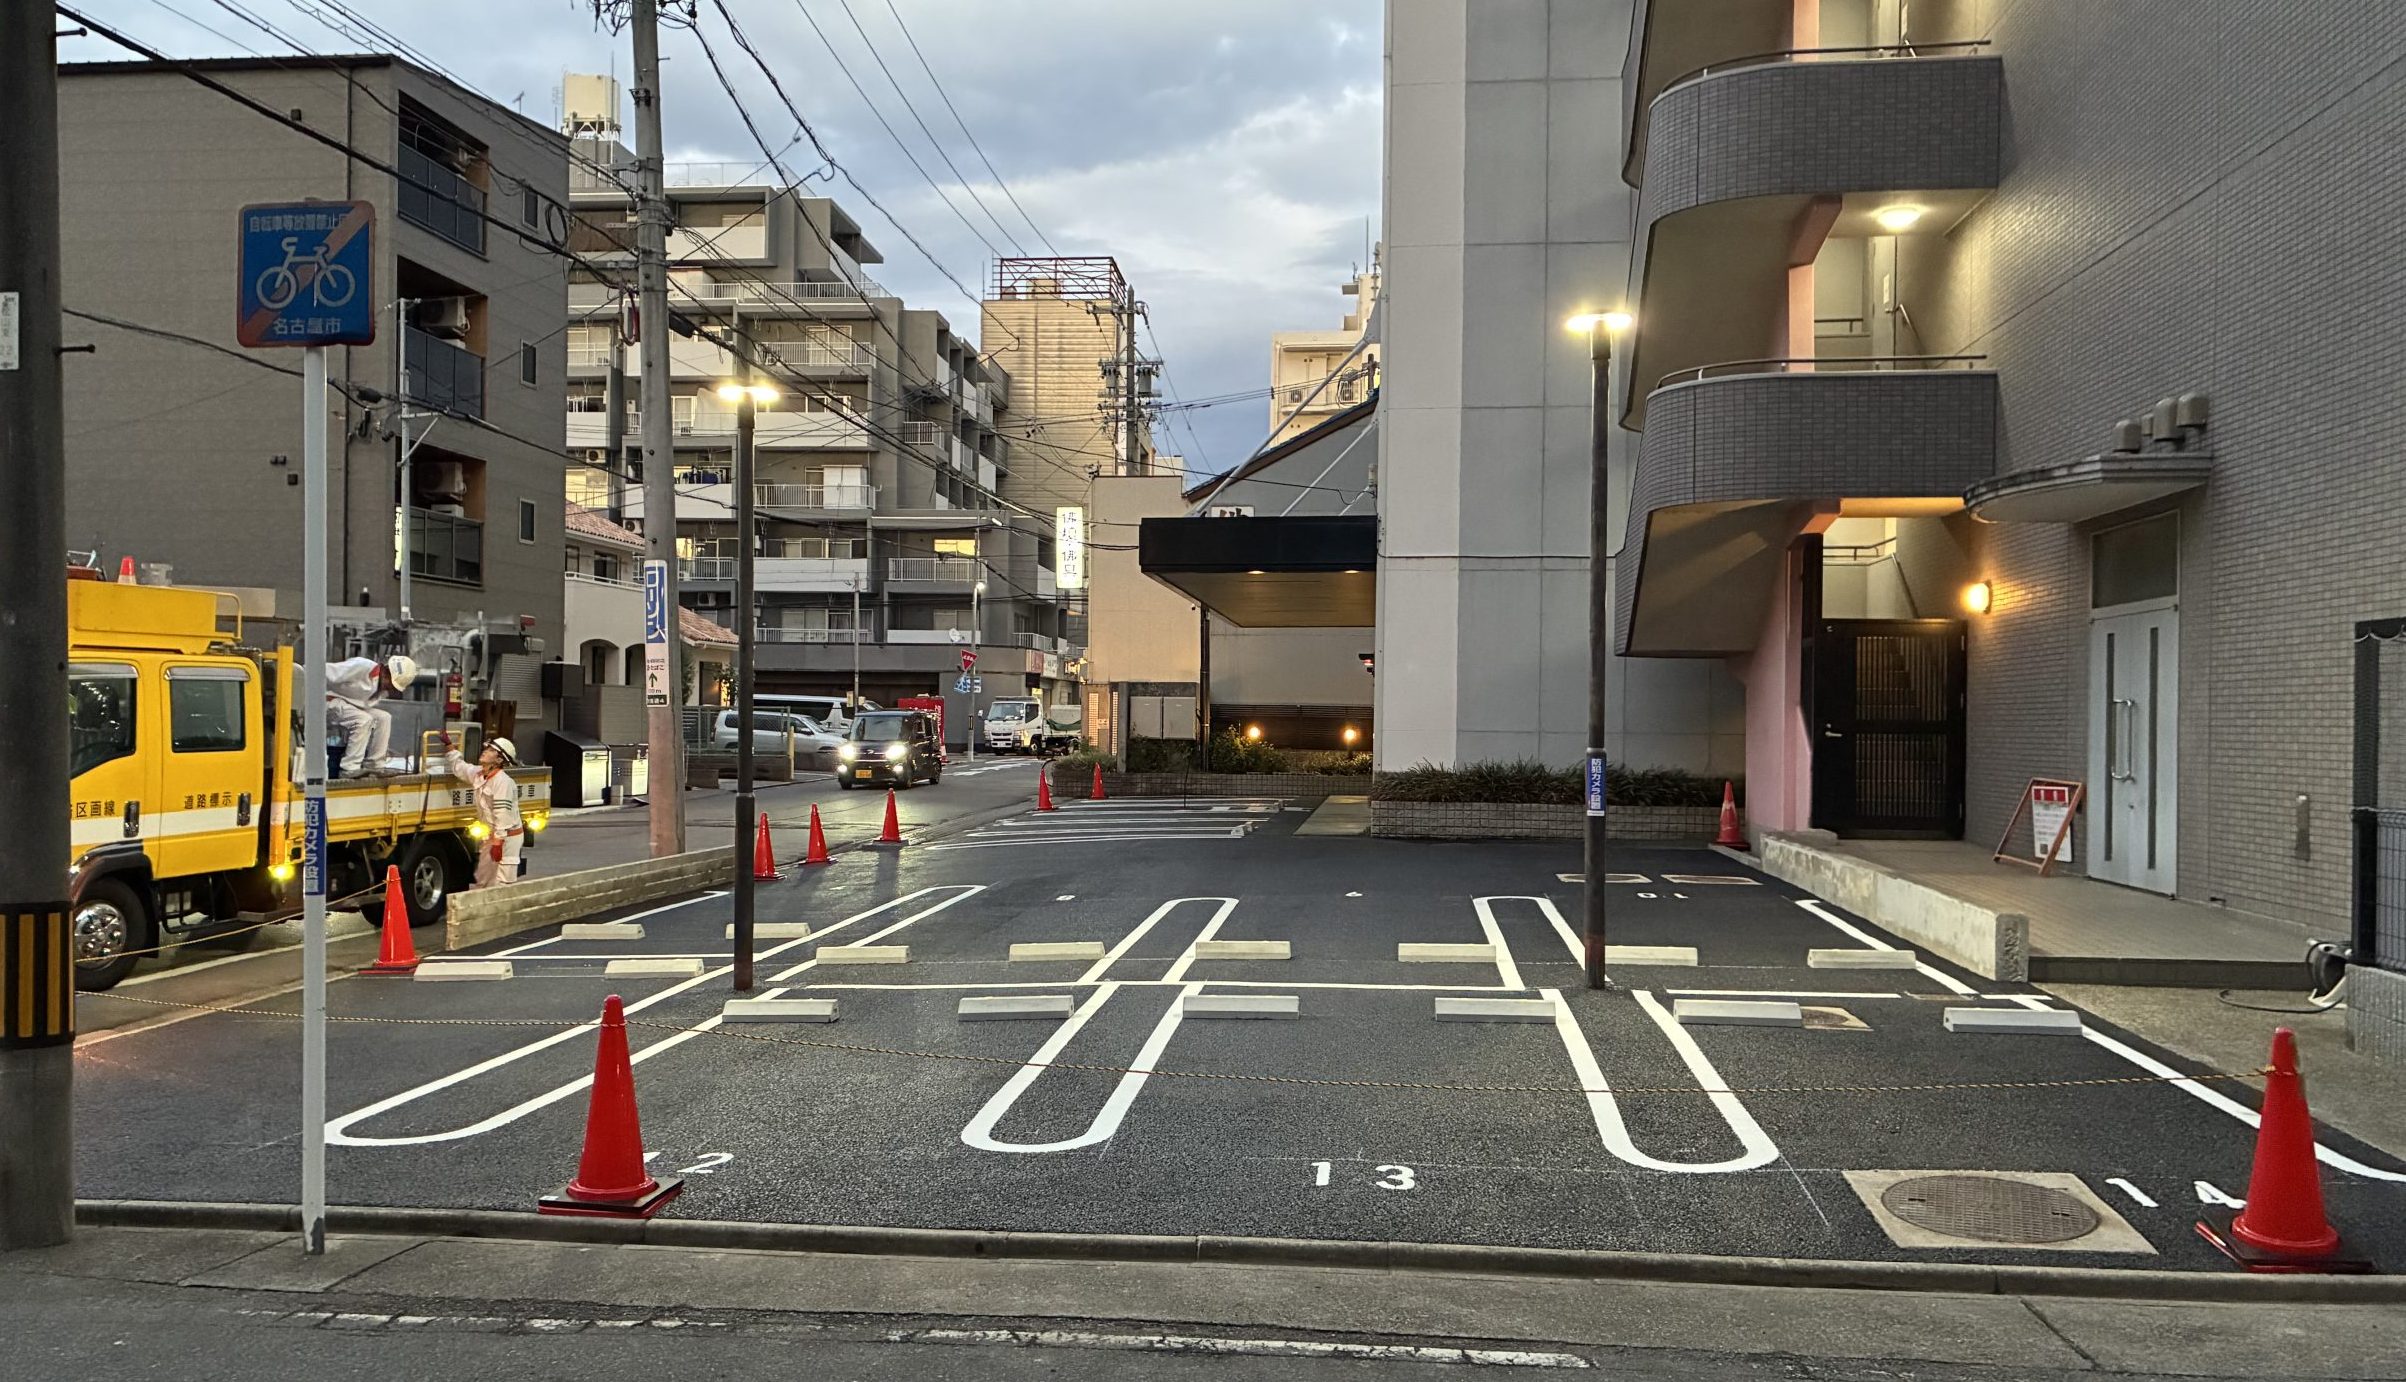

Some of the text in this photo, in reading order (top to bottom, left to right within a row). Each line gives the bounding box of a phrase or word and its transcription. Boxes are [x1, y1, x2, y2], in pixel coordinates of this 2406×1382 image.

[273, 318, 341, 334] 名古屋市
[646, 570, 660, 640] ローソン
[1591, 758, 1602, 810] 防犯カメラ設置
[184, 791, 232, 810] 道路標示
[1310, 1161, 1415, 1190] 13
